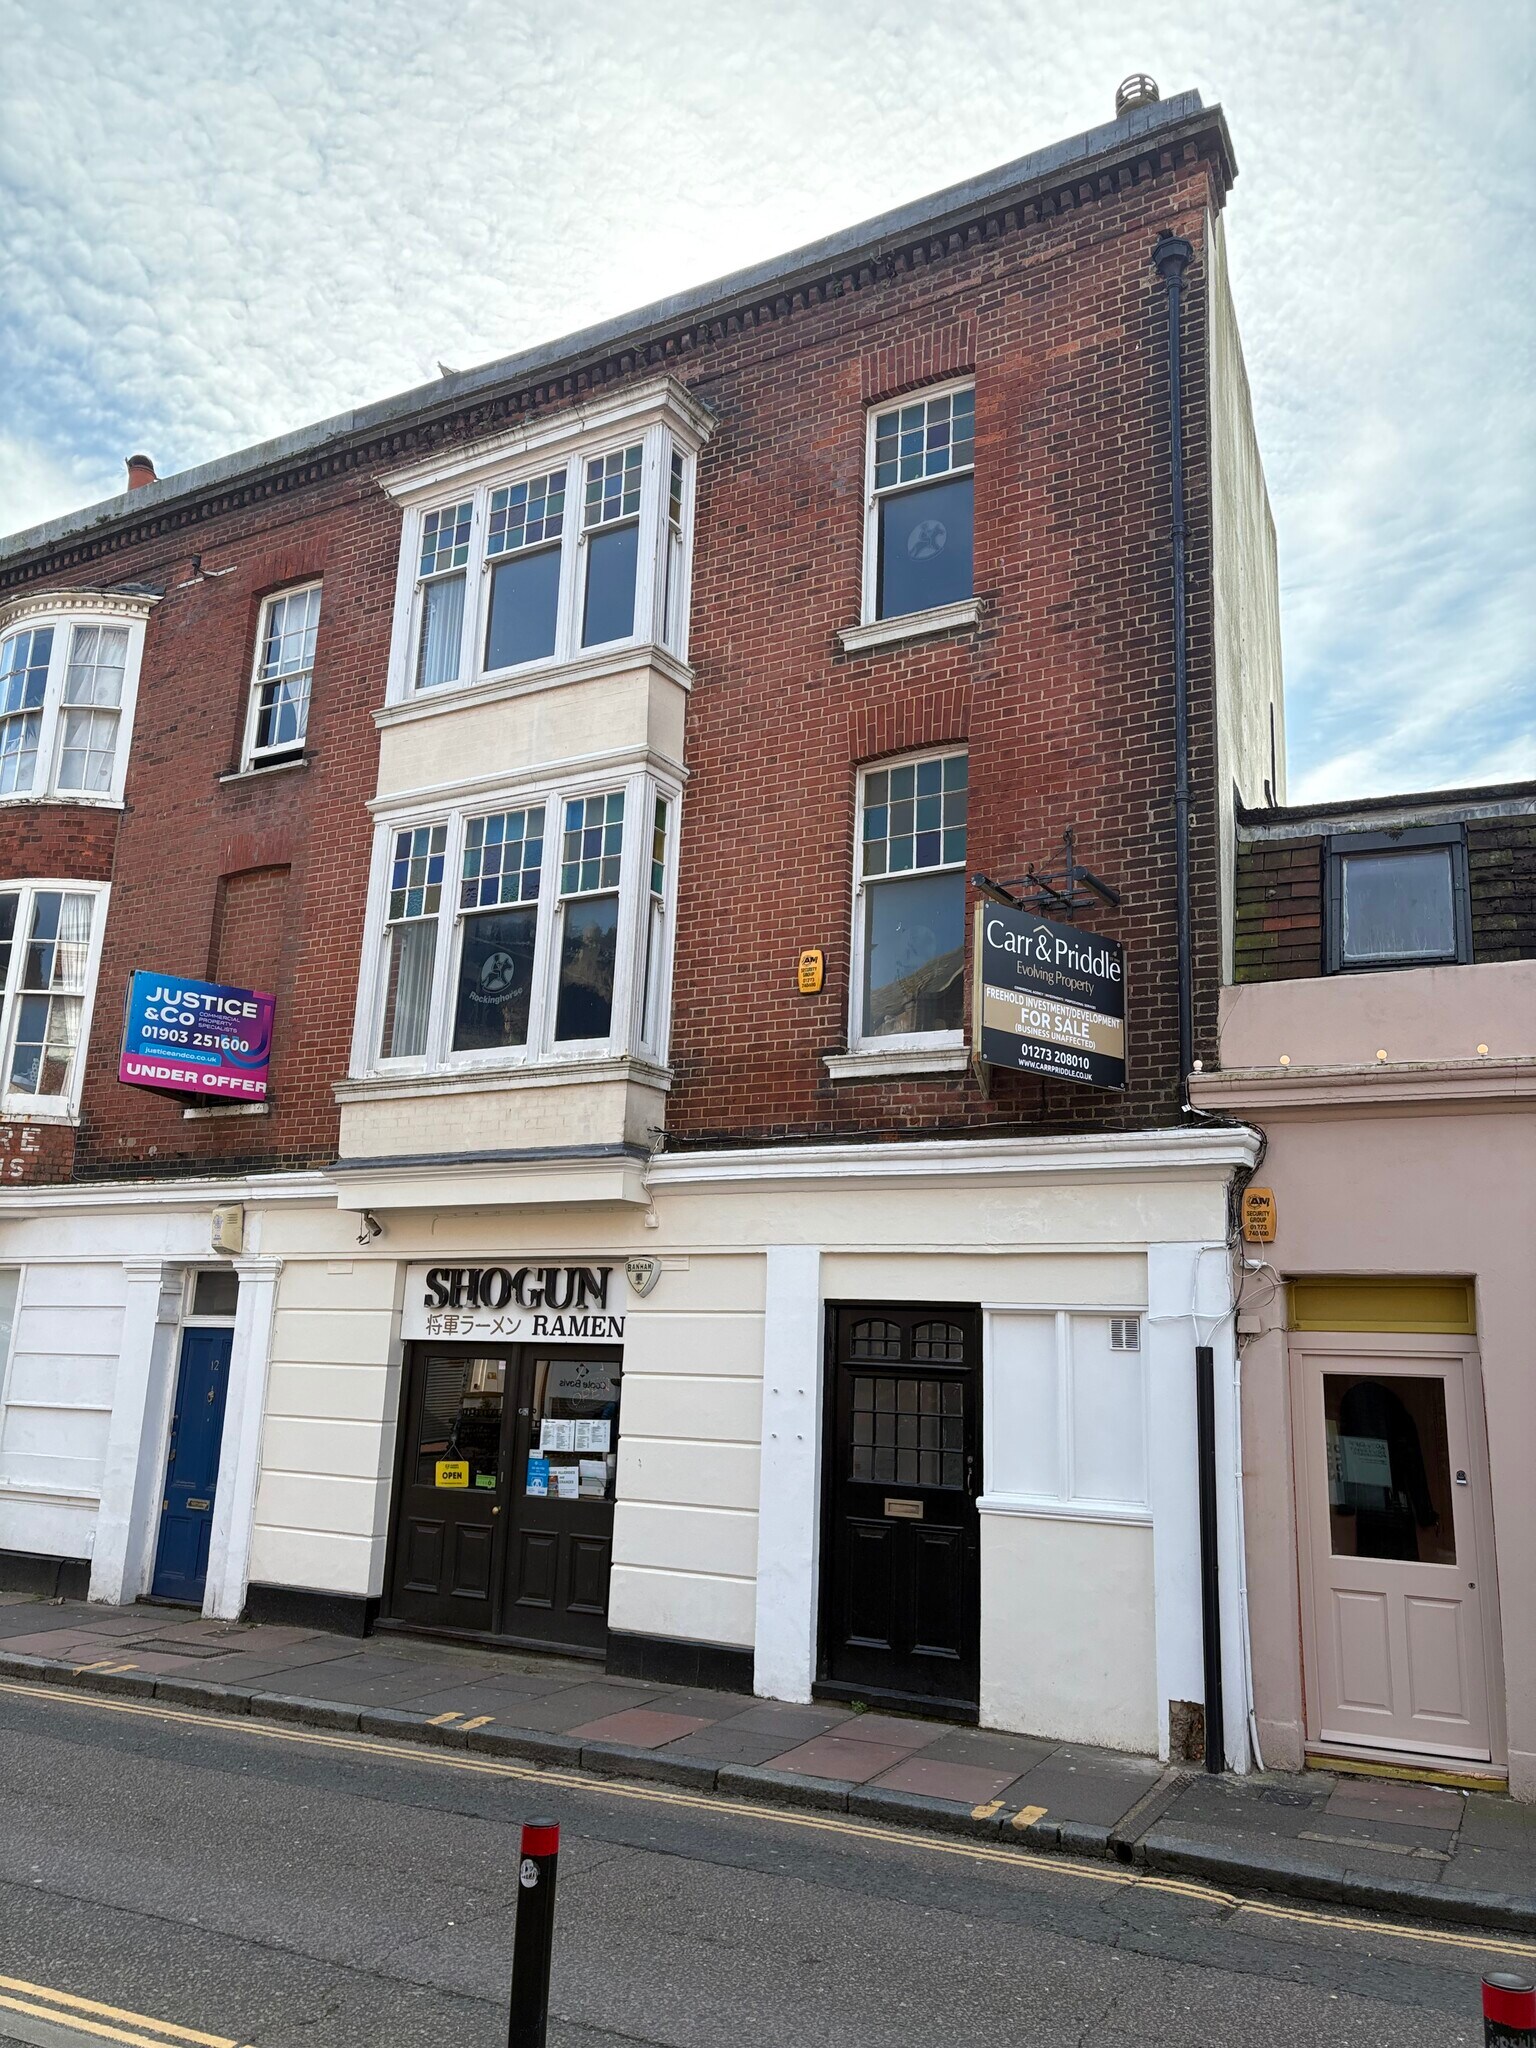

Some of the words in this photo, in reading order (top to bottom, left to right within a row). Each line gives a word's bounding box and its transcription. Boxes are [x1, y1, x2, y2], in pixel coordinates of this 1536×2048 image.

[986, 919, 1033, 956] Carr
[1035, 934, 1052, 963] &
[1055, 938, 1121, 982] Priddle
[1016, 960, 1054, 985] Evolving
[1055, 970, 1095, 996] Property
[146, 986, 258, 1019] JUSTICE
[469, 987, 523, 1005] Rockinghorse
[986, 986, 1024, 1006] FREEHOLD
[1025, 996, 1120, 1029] INVESTMENT/DEVELOPMENT
[198, 1022, 238, 1034] SPECIALISTS
[199, 1011, 241, 1023] COMMERCIAL
[199, 1017, 233, 1027] PROPERTY
[1020, 1007, 1051, 1030] FOR
[1054, 1016, 1090, 1039] SALE
[141, 1025, 188, 1043] 01903
[193, 1032, 249, 1053] 251600
[1014, 1023, 1050, 1039] (BUSINESS
[1051, 1031, 1096, 1050] UNAFFECTED)
[144, 1046, 217, 1063] justiceandco.co.uk
[1021, 1043, 1051, 1061] 01273
[1054, 1050, 1090, 1070] 208010
[126, 1062, 199, 1083] UNDER
[202, 1074, 267, 1094] OFFER
[1018, 1058, 1093, 1081] WWW.CARRPRIDDLE.CO.UK
[627, 1263, 652, 1272] BANHAM
[424, 1266, 614, 1311] SHOGUN
[425, 1313, 522, 1336] 将軍ラーメン
[531, 1314, 626, 1338] RAMEN
[211, 1360, 220, 1371] 12
[442, 1471, 463, 1479] OPEN
